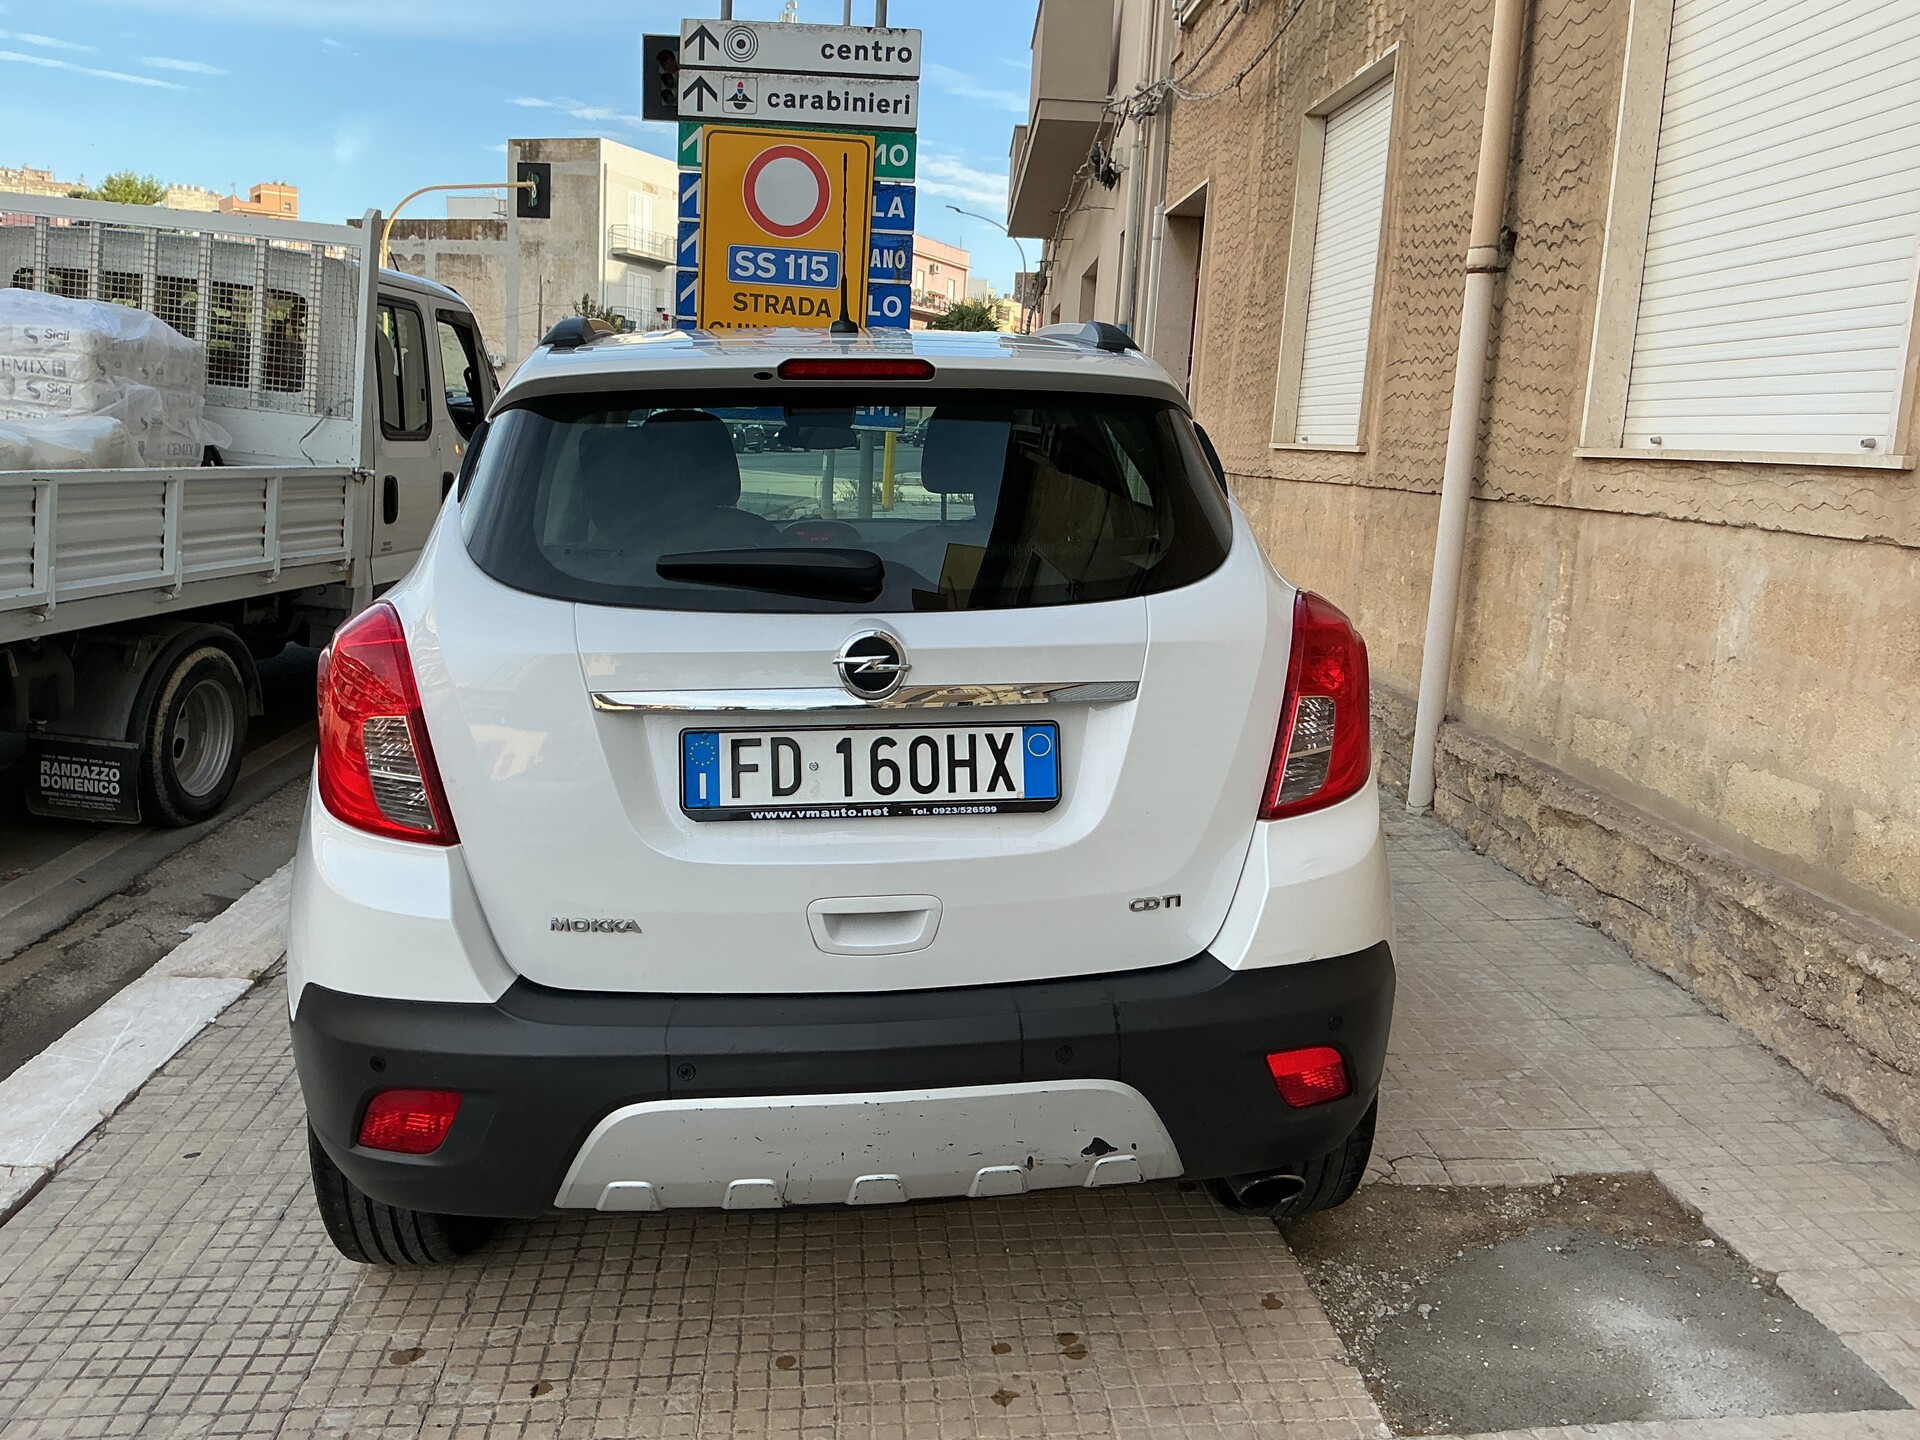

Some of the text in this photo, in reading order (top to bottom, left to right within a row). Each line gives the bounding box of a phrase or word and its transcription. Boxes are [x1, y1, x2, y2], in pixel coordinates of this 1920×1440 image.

[820, 40, 913, 64] centro
[767, 90, 911, 115] carabinieri
[734, 250, 829, 282] SS 115
[732, 291, 832, 318] STRADA
[44, 328, 70, 341] Sicil
[46, 382, 72, 396] Sicil
[40, 760, 120, 782] RANDAZZO
[730, 732, 1017, 799] FD 160HX
[40, 774, 120, 795] DOMENICO
[750, 806, 890, 820] www.vmauto.net
[911, 807, 930, 815] Tel.
[932, 805, 998, 815] 0923/526599
[1128, 893, 1182, 913] CDTI
[549, 916, 643, 934] MOKKA
